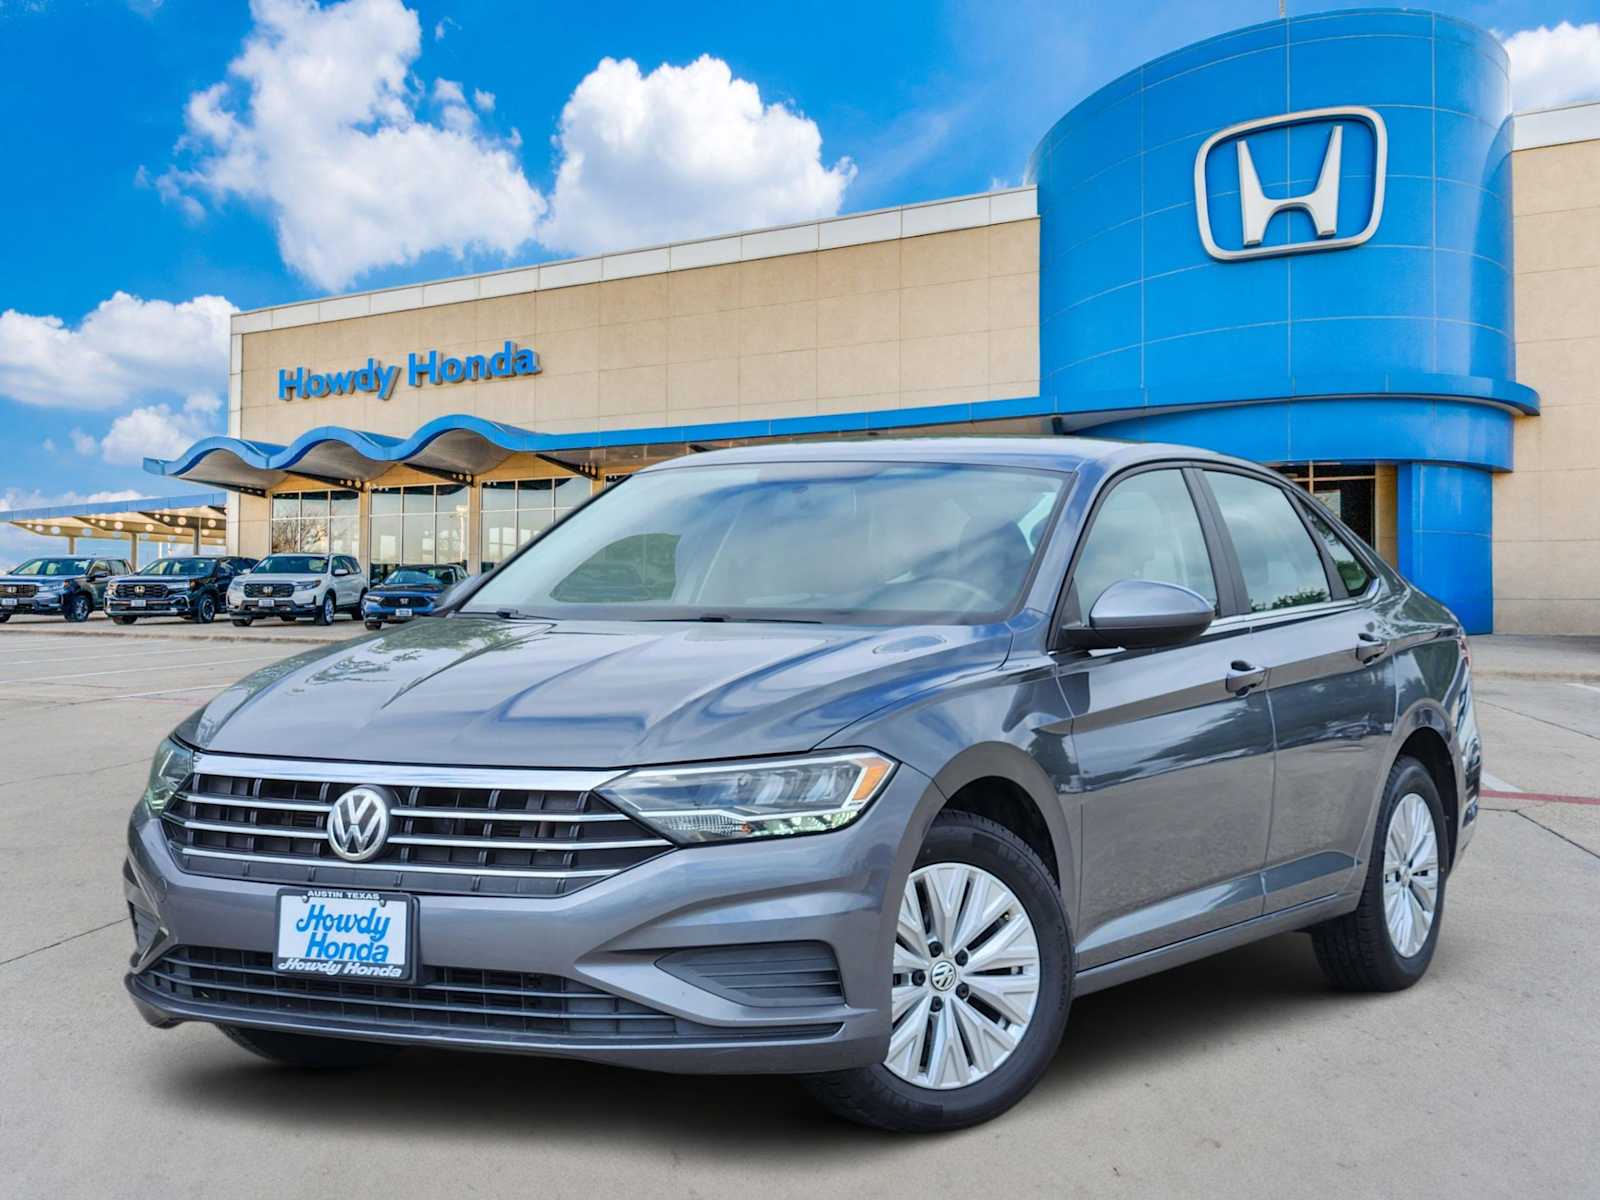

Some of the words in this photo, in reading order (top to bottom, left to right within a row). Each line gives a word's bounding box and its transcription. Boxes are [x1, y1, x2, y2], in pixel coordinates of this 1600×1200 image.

[278, 357, 401, 401] Howdy
[407, 340, 541, 387] Honda
[307, 890, 344, 898] AUSTIN
[346, 892, 380, 900] TEXAS
[296, 904, 391, 942] Howdy
[305, 931, 389, 962] Honda
[278, 958, 342, 976] Howdy
[343, 961, 402, 978] Honda
